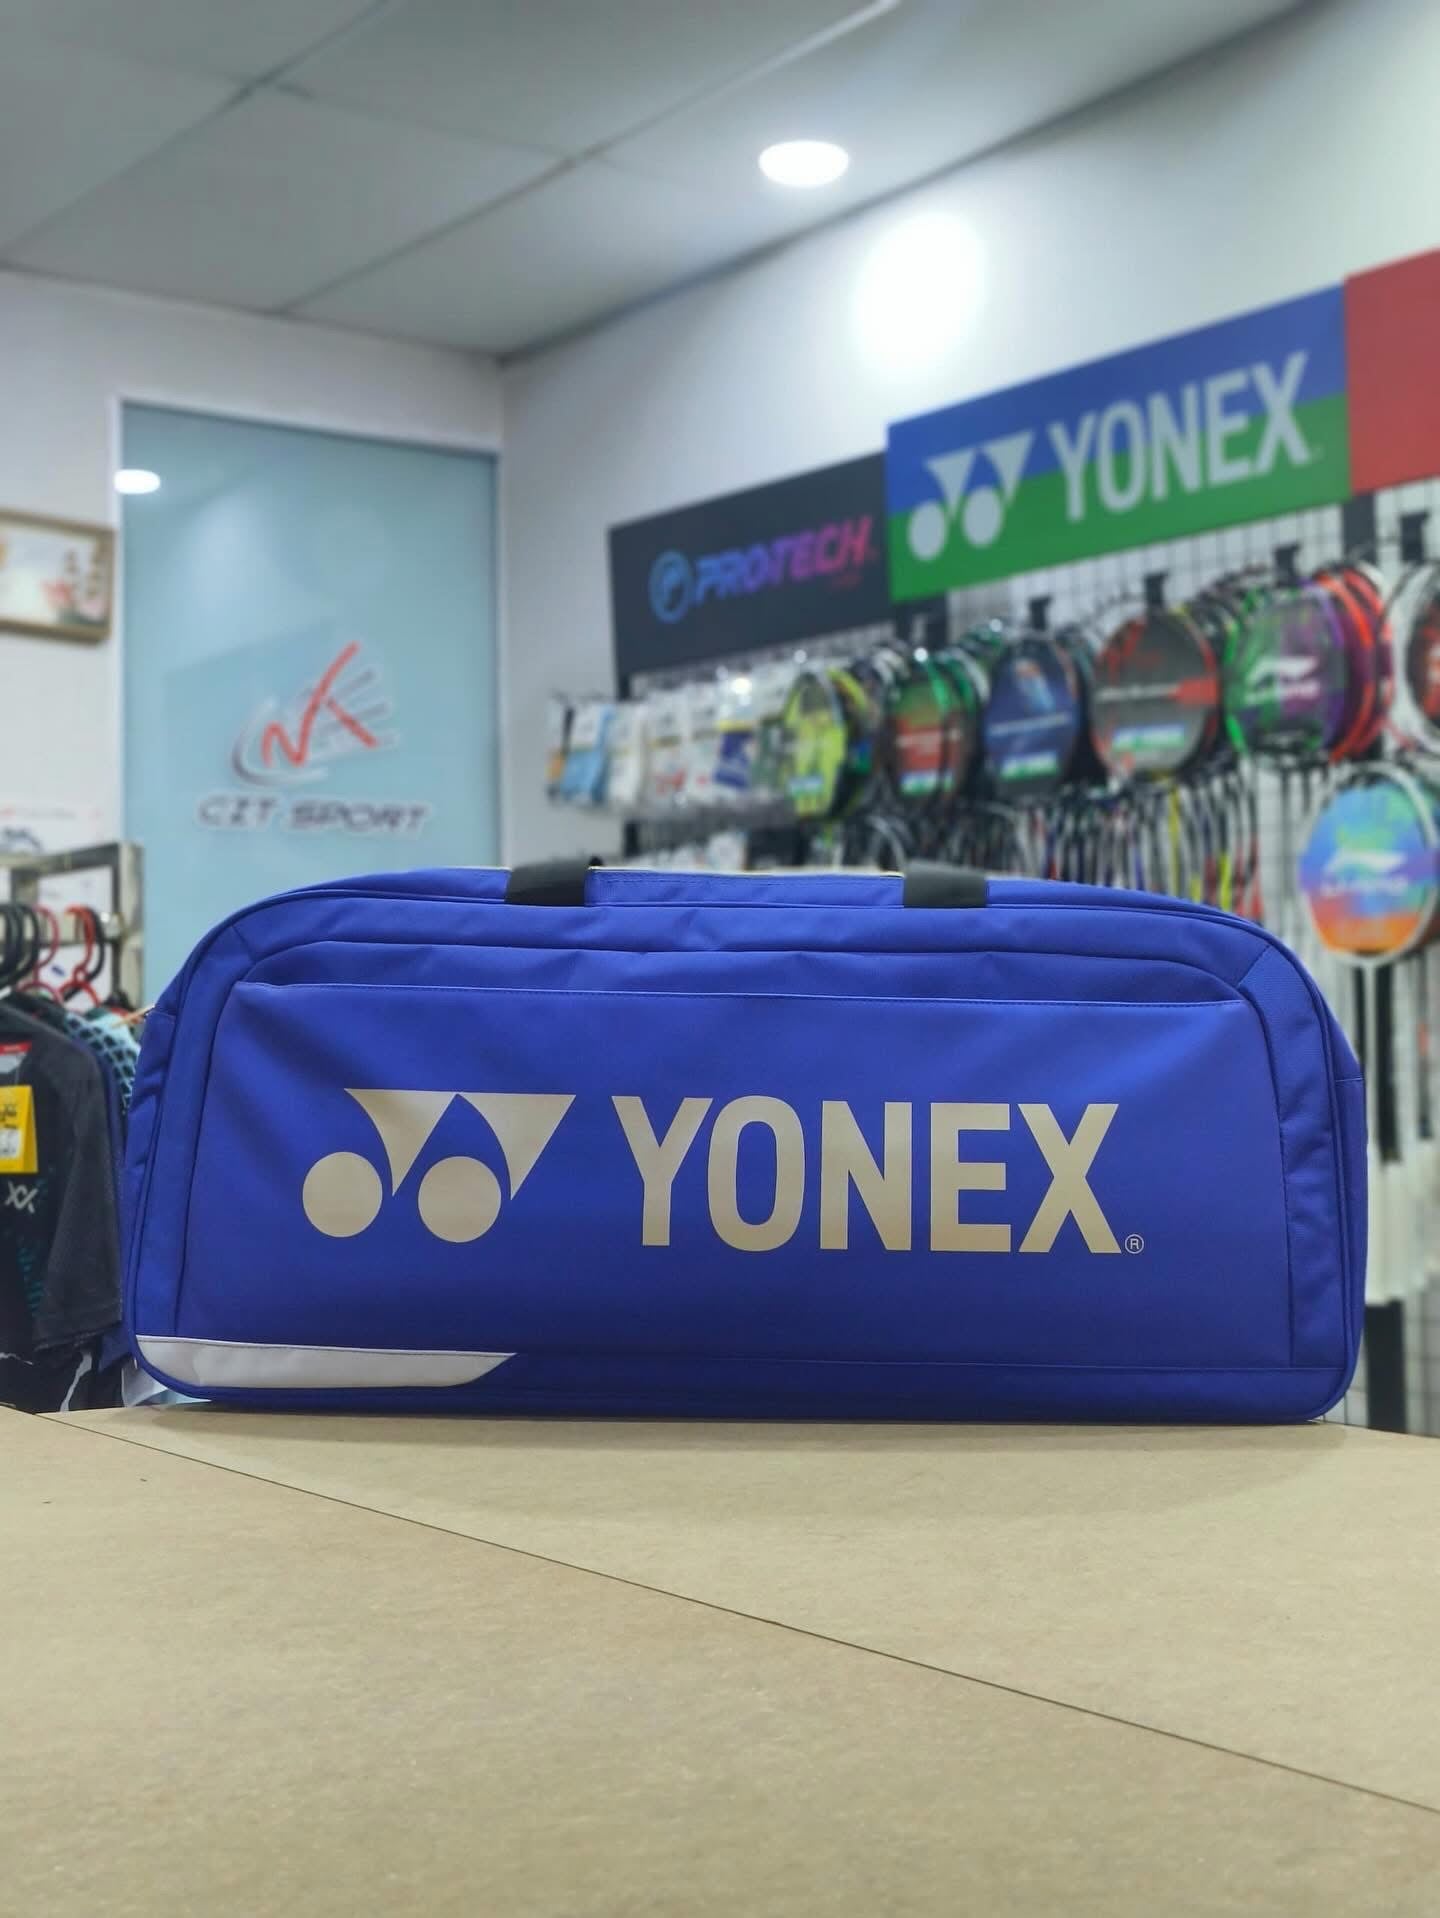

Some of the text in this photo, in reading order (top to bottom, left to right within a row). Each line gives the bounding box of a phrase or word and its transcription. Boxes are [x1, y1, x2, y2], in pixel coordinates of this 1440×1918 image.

[1048, 351, 1309, 521] YONEX
[693, 516, 872, 606] PROTECH
[611, 1095, 1122, 1254] YONEX
